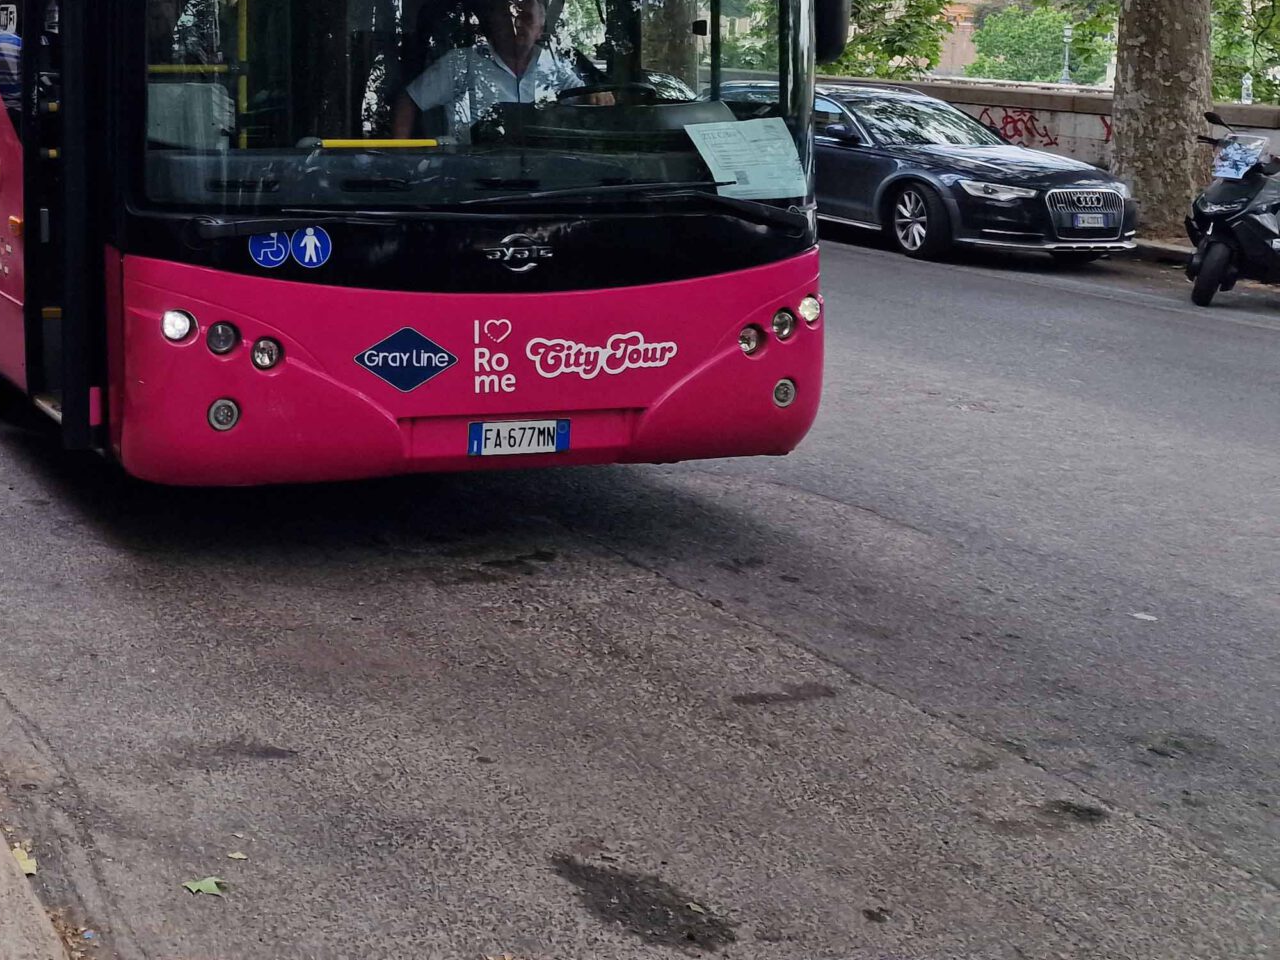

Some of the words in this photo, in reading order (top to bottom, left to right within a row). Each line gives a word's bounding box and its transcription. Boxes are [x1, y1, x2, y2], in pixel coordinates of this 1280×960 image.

[474, 320, 480, 344] I
[474, 347, 509, 372] Ro
[526, 337, 602, 380] City
[601, 331, 677, 376] Tour
[474, 373, 516, 394] me
